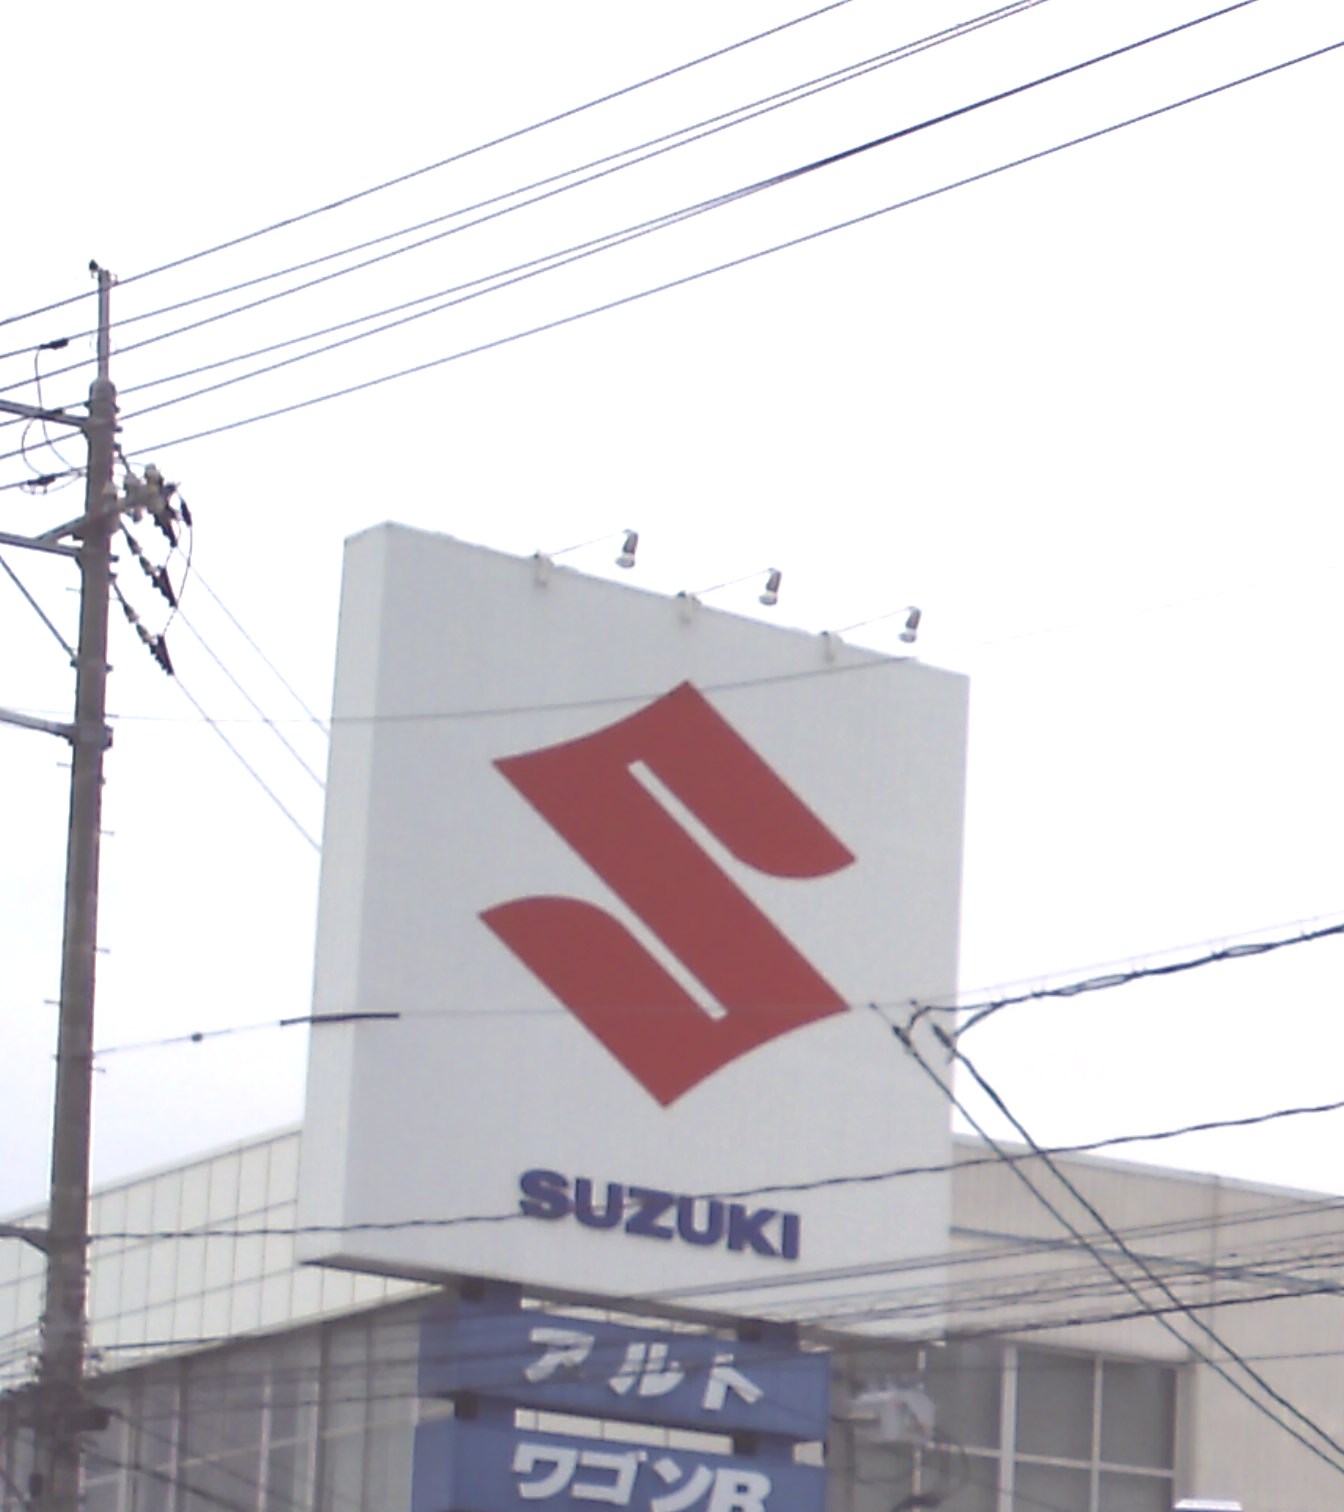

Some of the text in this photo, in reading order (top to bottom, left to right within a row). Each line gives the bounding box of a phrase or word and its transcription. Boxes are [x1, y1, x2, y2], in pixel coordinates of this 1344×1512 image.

[519, 1168, 801, 1260] SUZUKI
[523, 1327, 764, 1411] アルト
